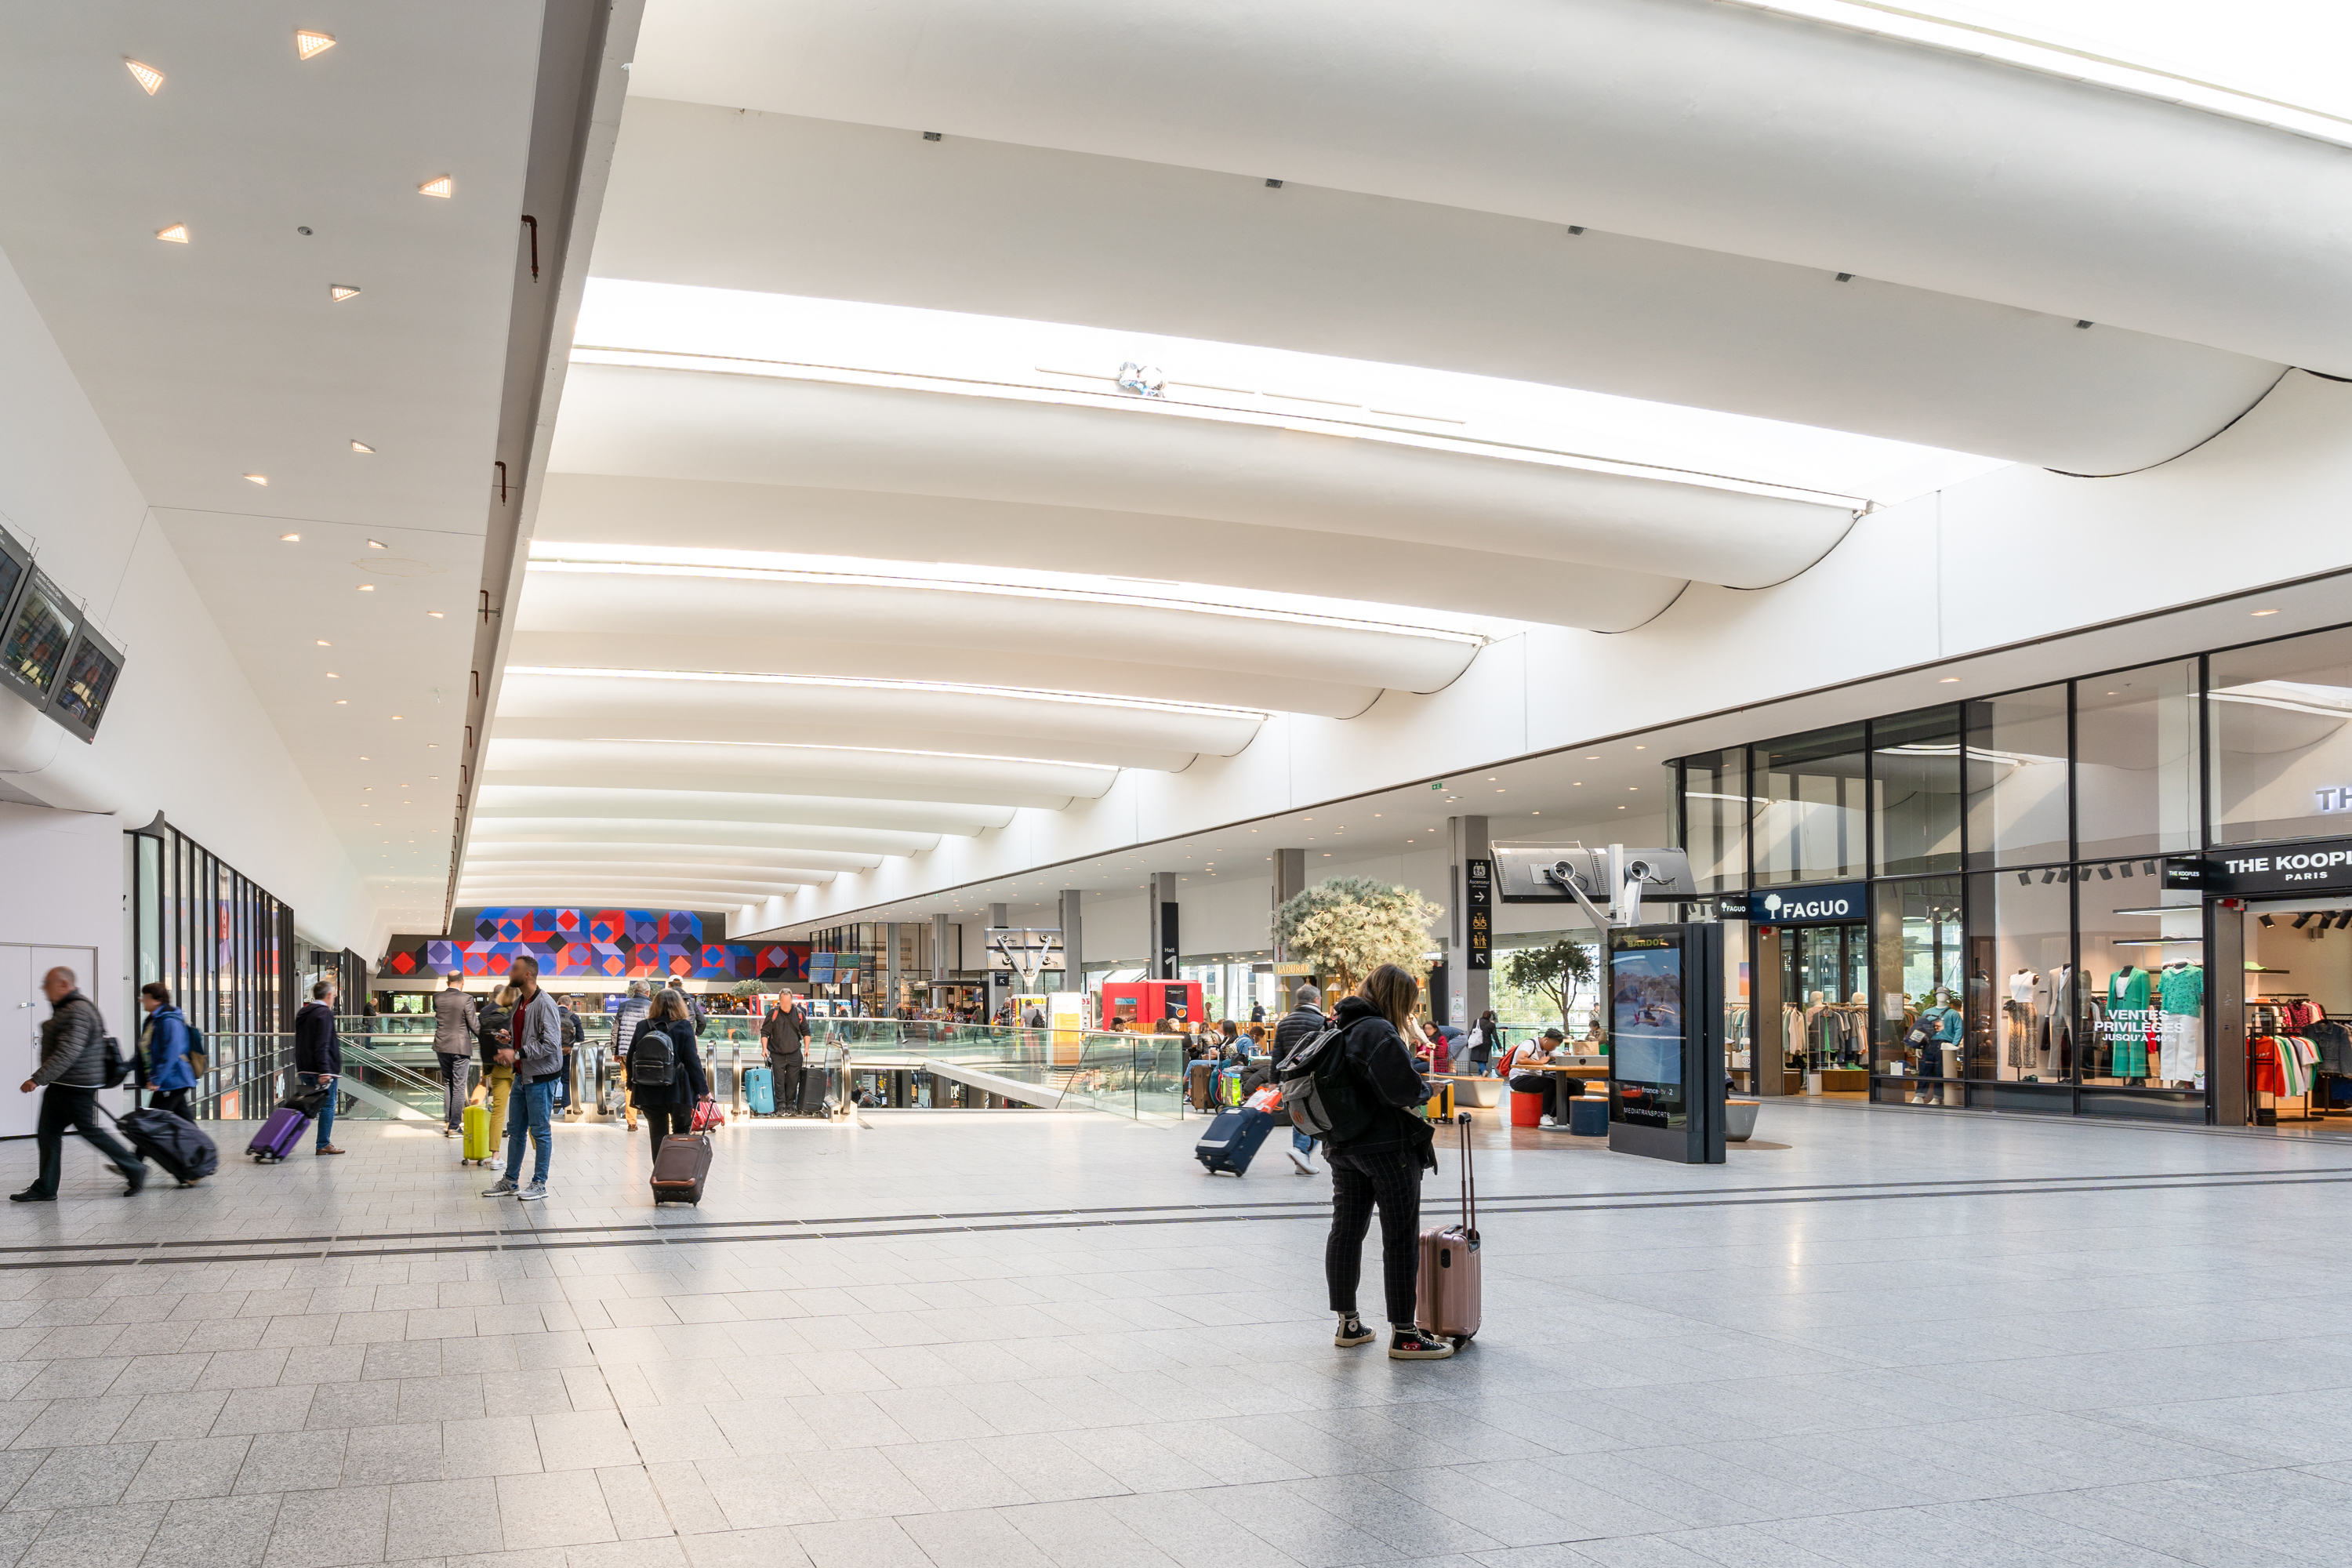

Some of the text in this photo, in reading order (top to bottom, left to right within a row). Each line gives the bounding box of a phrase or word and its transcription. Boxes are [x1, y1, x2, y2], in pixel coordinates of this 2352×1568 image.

[2225, 858, 2270, 873] THE
[2285, 871, 2328, 880] PARIS
[1783, 899, 1849, 918] FAGUO
[1628, 938, 1664, 947] BARDOT
[1164, 955, 1177, 979] 1
[1276, 964, 1310, 975] LADURÉE
[2107, 1009, 2169, 1020] VENTES
[2094, 1020, 2185, 1033] PRIVILÈGES
[2151, 1034, 2176, 1043] -40%
[1624, 1107, 1671, 1119] MEDIATRANSPORTS
